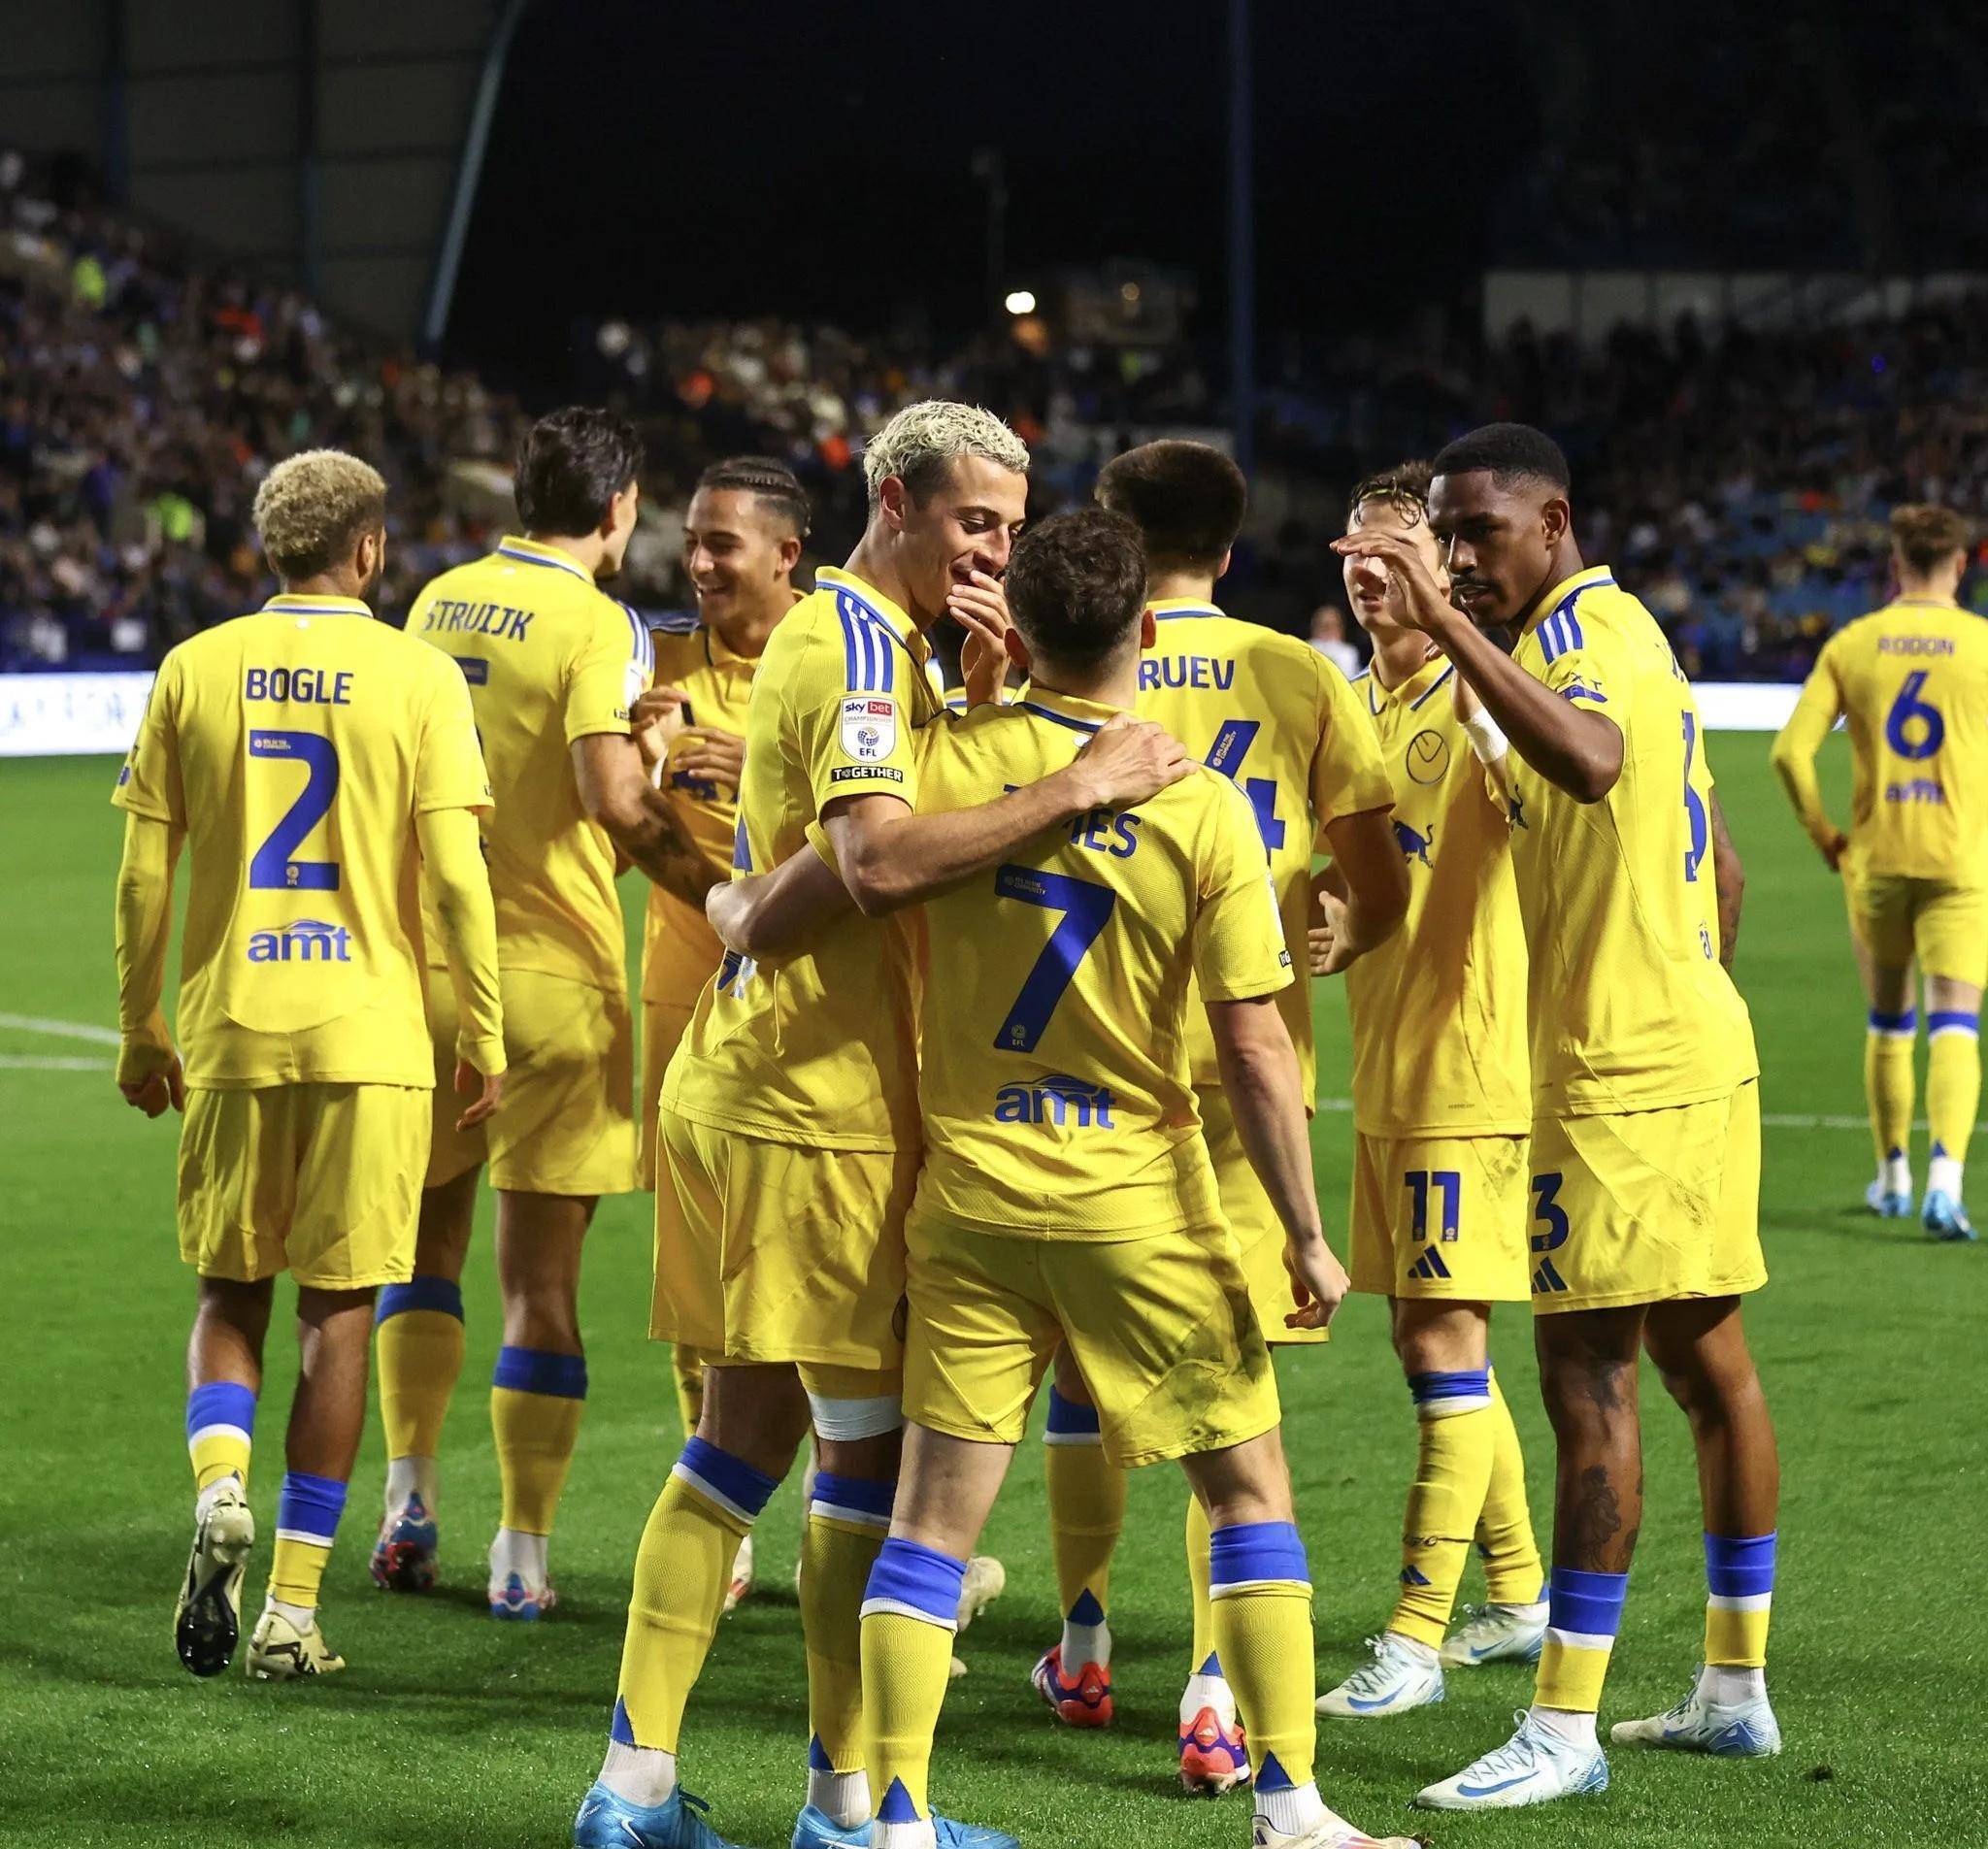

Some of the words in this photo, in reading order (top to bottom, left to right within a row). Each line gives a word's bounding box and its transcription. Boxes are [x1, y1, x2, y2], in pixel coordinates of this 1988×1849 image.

[424, 600, 534, 642] STRUIJK
[246, 668, 354, 705] BOGLE
[845, 702, 866, 712] sky
[870, 702, 890, 713] bet
[1886, 670, 1945, 760] 6
[859, 747, 877, 757] EFL
[249, 729, 340, 891] 2
[248, 926, 351, 963] amt
[994, 864, 1116, 1052] 7
[995, 1086, 1116, 1129] amt
[1405, 1171, 1460, 1242] 11
[1531, 1172, 1570, 1252] 3
